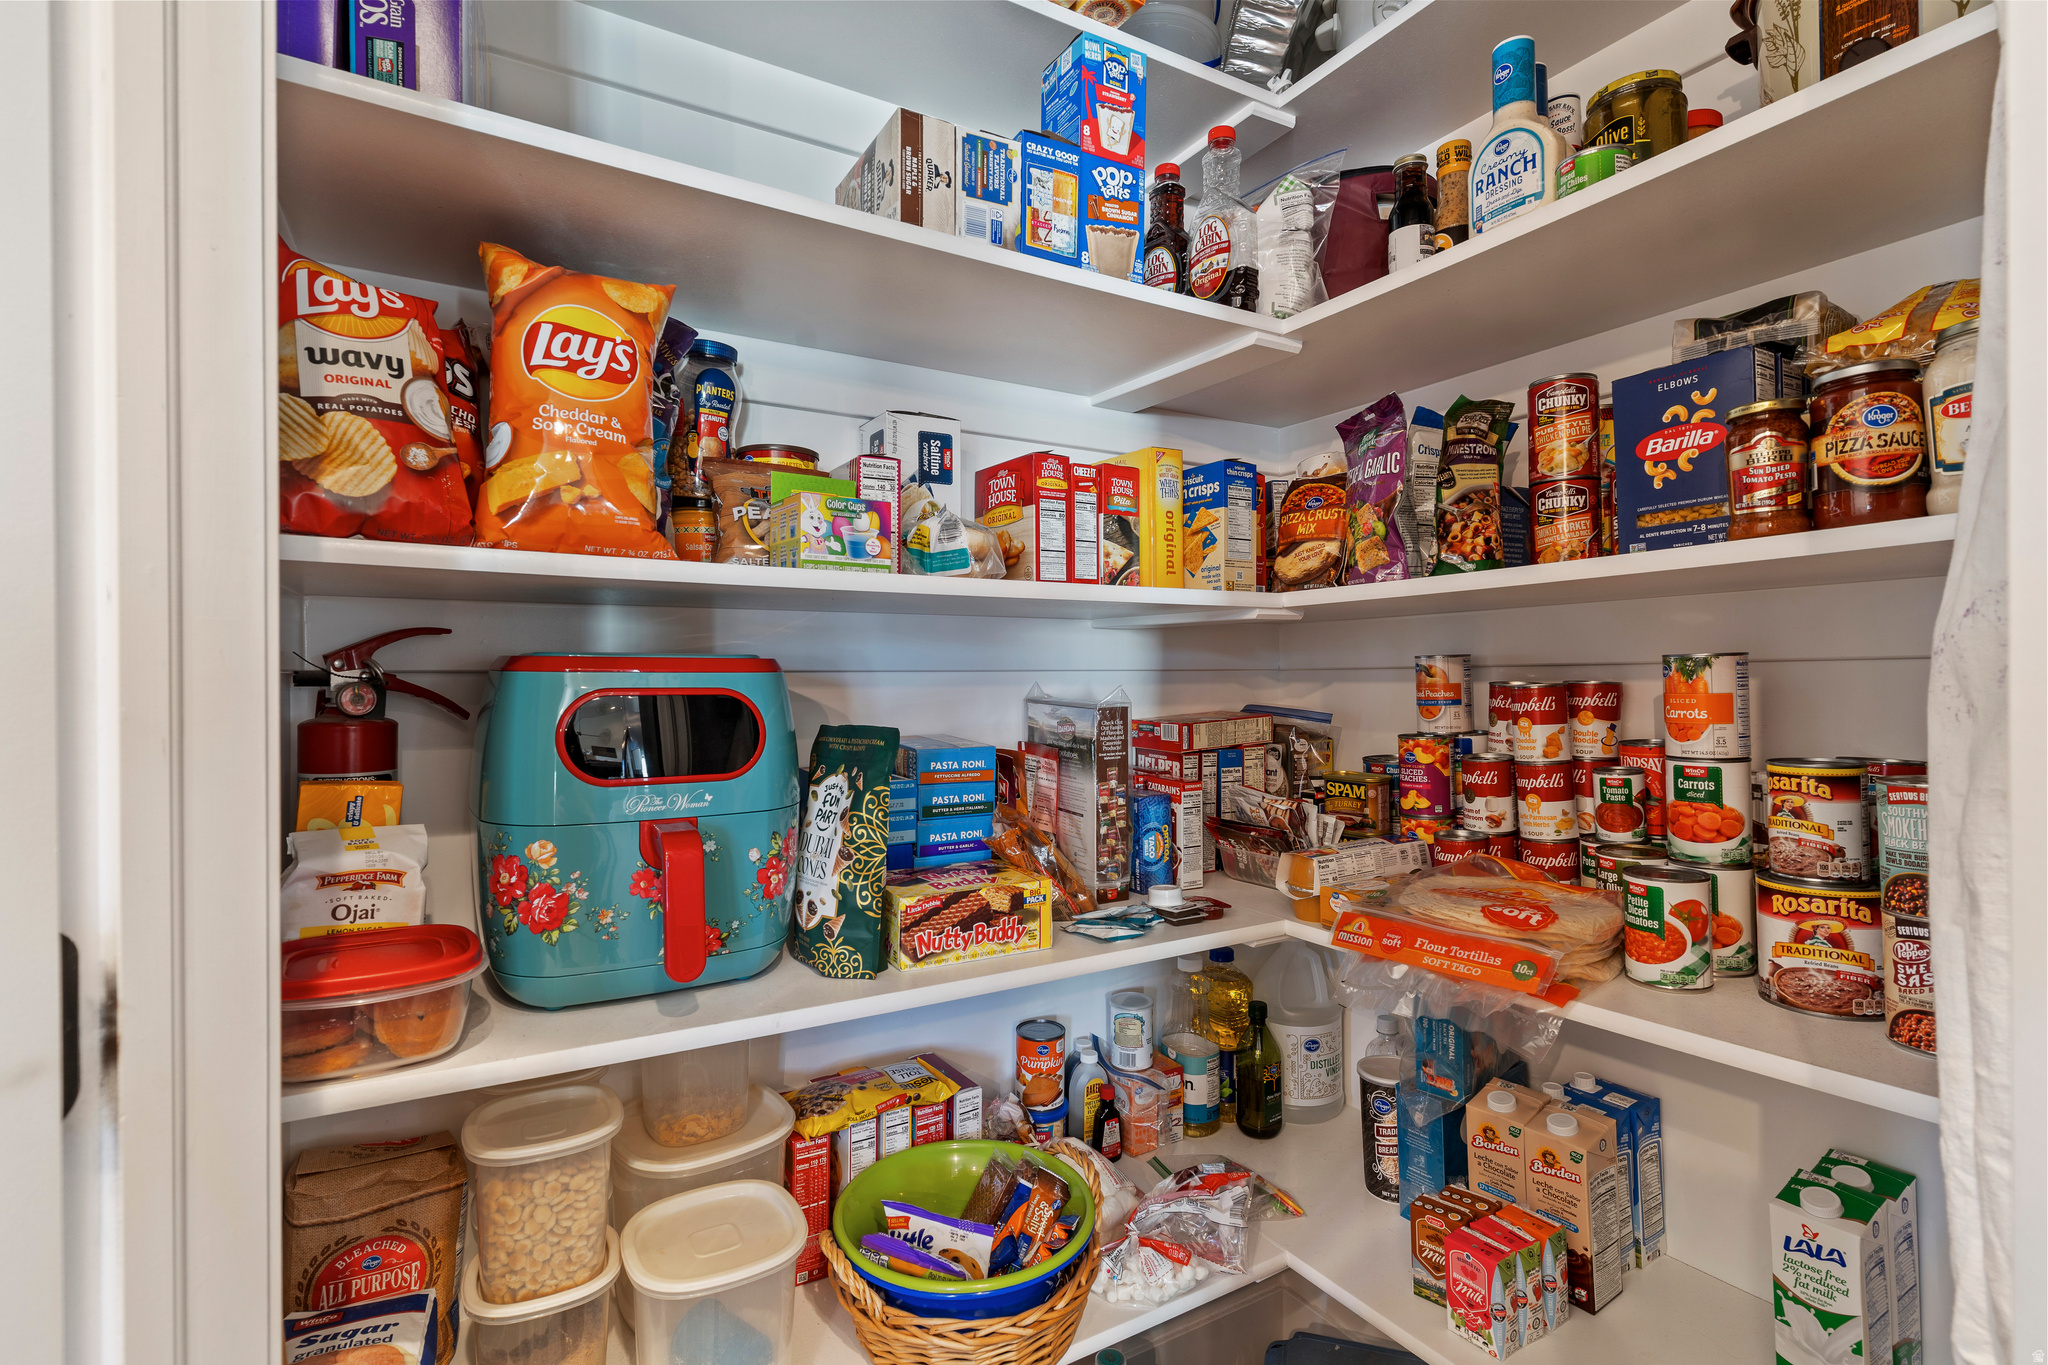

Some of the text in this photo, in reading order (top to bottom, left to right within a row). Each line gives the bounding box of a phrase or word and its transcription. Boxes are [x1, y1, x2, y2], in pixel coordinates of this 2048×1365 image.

[1843, 20, 1874, 38] AUTOMATIC
[1083, 125, 1091, 135] 8
[1551, 115, 1571, 128] Sauce
[1026, 142, 1078, 162] CRAZY GOOD
[1481, 148, 1530, 175] Creamy
[925, 158, 933, 193] QUAKER
[1475, 153, 1537, 198] RANCH
[1485, 176, 1523, 199] DRESSING
[1198, 220, 1217, 238] LOG
[1195, 231, 1223, 253] CABIN
[1081, 251, 1090, 264] 8
[1147, 252, 1165, 266] LOG
[1144, 262, 1169, 281] CABIN
[1194, 269, 1222, 287] Original
[529, 323, 634, 381] Lay's
[304, 346, 405, 379] wavy
[324, 373, 392, 390] ORIGINAL
[1657, 374, 1698, 392] ELBOWS
[696, 383, 734, 402] PLANTERS
[317, 402, 404, 418] REAL POTATOES
[1538, 394, 1587, 412] CHUNKY
[538, 404, 623, 430] Cheddar &
[700, 413, 726, 424] PEANUTS
[1867, 409, 1894, 425] Kroger
[576, 422, 627, 445] Cream
[1536, 419, 1591, 437] PUB-STYLE
[1645, 428, 1714, 456] Barilla
[1824, 431, 1924, 459] PIZZA SAUCE
[862, 461, 896, 471] Nutrition Facts
[930, 440, 942, 475] Saltine
[1364, 451, 1400, 479] GARLIC
[1746, 454, 1793, 466] BERIO
[1041, 461, 1064, 472] TOWN
[1041, 468, 1065, 480] HOUSE
[988, 477, 1016, 492] TOWN
[1041, 480, 1064, 489] ORIGINAL
[1112, 478, 1132, 488] TOWN
[1159, 479, 1180, 489] WHEAT
[1743, 472, 1798, 485] TOMATO PESTO
[988, 488, 1018, 504] HOUSE
[1111, 485, 1134, 497] HOUSE
[1160, 487, 1180, 501] THINS
[1188, 480, 1221, 499] crisps
[826, 499, 866, 513] Color Cups
[1113, 495, 1132, 506] Pita
[1538, 495, 1586, 512] CHUNKY
[988, 512, 1017, 526] ORIGINAL
[1282, 508, 1346, 527] PIZZA CRUST
[1297, 523, 1316, 535] MIX
[1536, 520, 1591, 541] SMOKED TURKEY
[686, 542, 702, 551] Salsa
[1165, 510, 1178, 576] original
[1201, 564, 1222, 575] original
[1425, 690, 1455, 698] Peaches
[1664, 706, 1709, 720] Carrots
[1573, 730, 1599, 738] Double
[1573, 737, 1599, 746] Noodle
[1517, 744, 1537, 752] Cheese
[930, 758, 985, 770] PASTA RONI
[1137, 755, 1181, 777] HELPER
[1401, 768, 1424, 777] SLICED
[1621, 755, 1664, 775] LINDSAY
[1148, 782, 1181, 797] ZATARAIN'S
[1326, 782, 1366, 799] SPAM
[1602, 786, 1630, 796] Tomato
[1677, 778, 1715, 790] Carrots
[626, 789, 710, 816] Pioneer Woman
[932, 793, 986, 805] PASTA RONI
[1334, 800, 1362, 810] TURKEY
[1605, 794, 1626, 803] Paste
[814, 808, 838, 825] PART
[1529, 814, 1557, 822] Parmesan
[930, 829, 982, 843] PASTA RONI
[1161, 824, 1170, 863] ORTEGA
[800, 831, 834, 859] DUBAI
[1148, 835, 1156, 858] TACO
[1801, 841, 1831, 851] FIBER
[798, 855, 828, 880] CONES
[1597, 868, 1618, 882] Large
[324, 872, 398, 885] PEPPERIDGE FARM
[330, 896, 353, 904] SOFT
[1026, 894, 1045, 904] PACK
[1028, 889, 1042, 897] BIG
[1627, 894, 1649, 908] Petite
[331, 903, 376, 924] Ojai
[923, 899, 942, 911] Debbie
[1628, 904, 1648, 917] Diced
[1772, 895, 1873, 924] Rosarita
[914, 916, 1029, 958] Nutty Buddy
[1338, 931, 1373, 948] MISSION
[1382, 937, 1403, 949] soft
[1414, 938, 1503, 967] Flour Tortillas
[1780, 945, 1866, 966] TRADITIONAL
[1422, 955, 1482, 977] SOFT TACO
[1515, 963, 1535, 976] 10ct
[1840, 973, 1872, 985] FIBER
[1448, 1025, 1456, 1061] ORIGINAL
[1020, 1055, 1064, 1072] Pumpkin
[1472, 1137, 1519, 1157] Borden
[1474, 1152, 1493, 1165] Leche
[1482, 1163, 1517, 1181] Chocolate
[1531, 1161, 1581, 1185] Borden
[1532, 1177, 1552, 1190] Leche
[1542, 1188, 1578, 1209] Chocolate
[1027, 1208, 1046, 1235] Salty
[1035, 1205, 1054, 1242] Sweet
[335, 1240, 408, 1271] BLEACHED
[1784, 1235, 1847, 1268] LALA
[1784, 1253, 1847, 1287] lactose free
[319, 1260, 422, 1312] ALL PURPOSE
[1453, 1272, 1485, 1296] strawberry
[1782, 1265, 1850, 1298] 2% reduced
[1793, 1276, 1837, 1303] fat milk
[295, 1320, 399, 1350] Sugar
[292, 1334, 394, 1363] granulated
